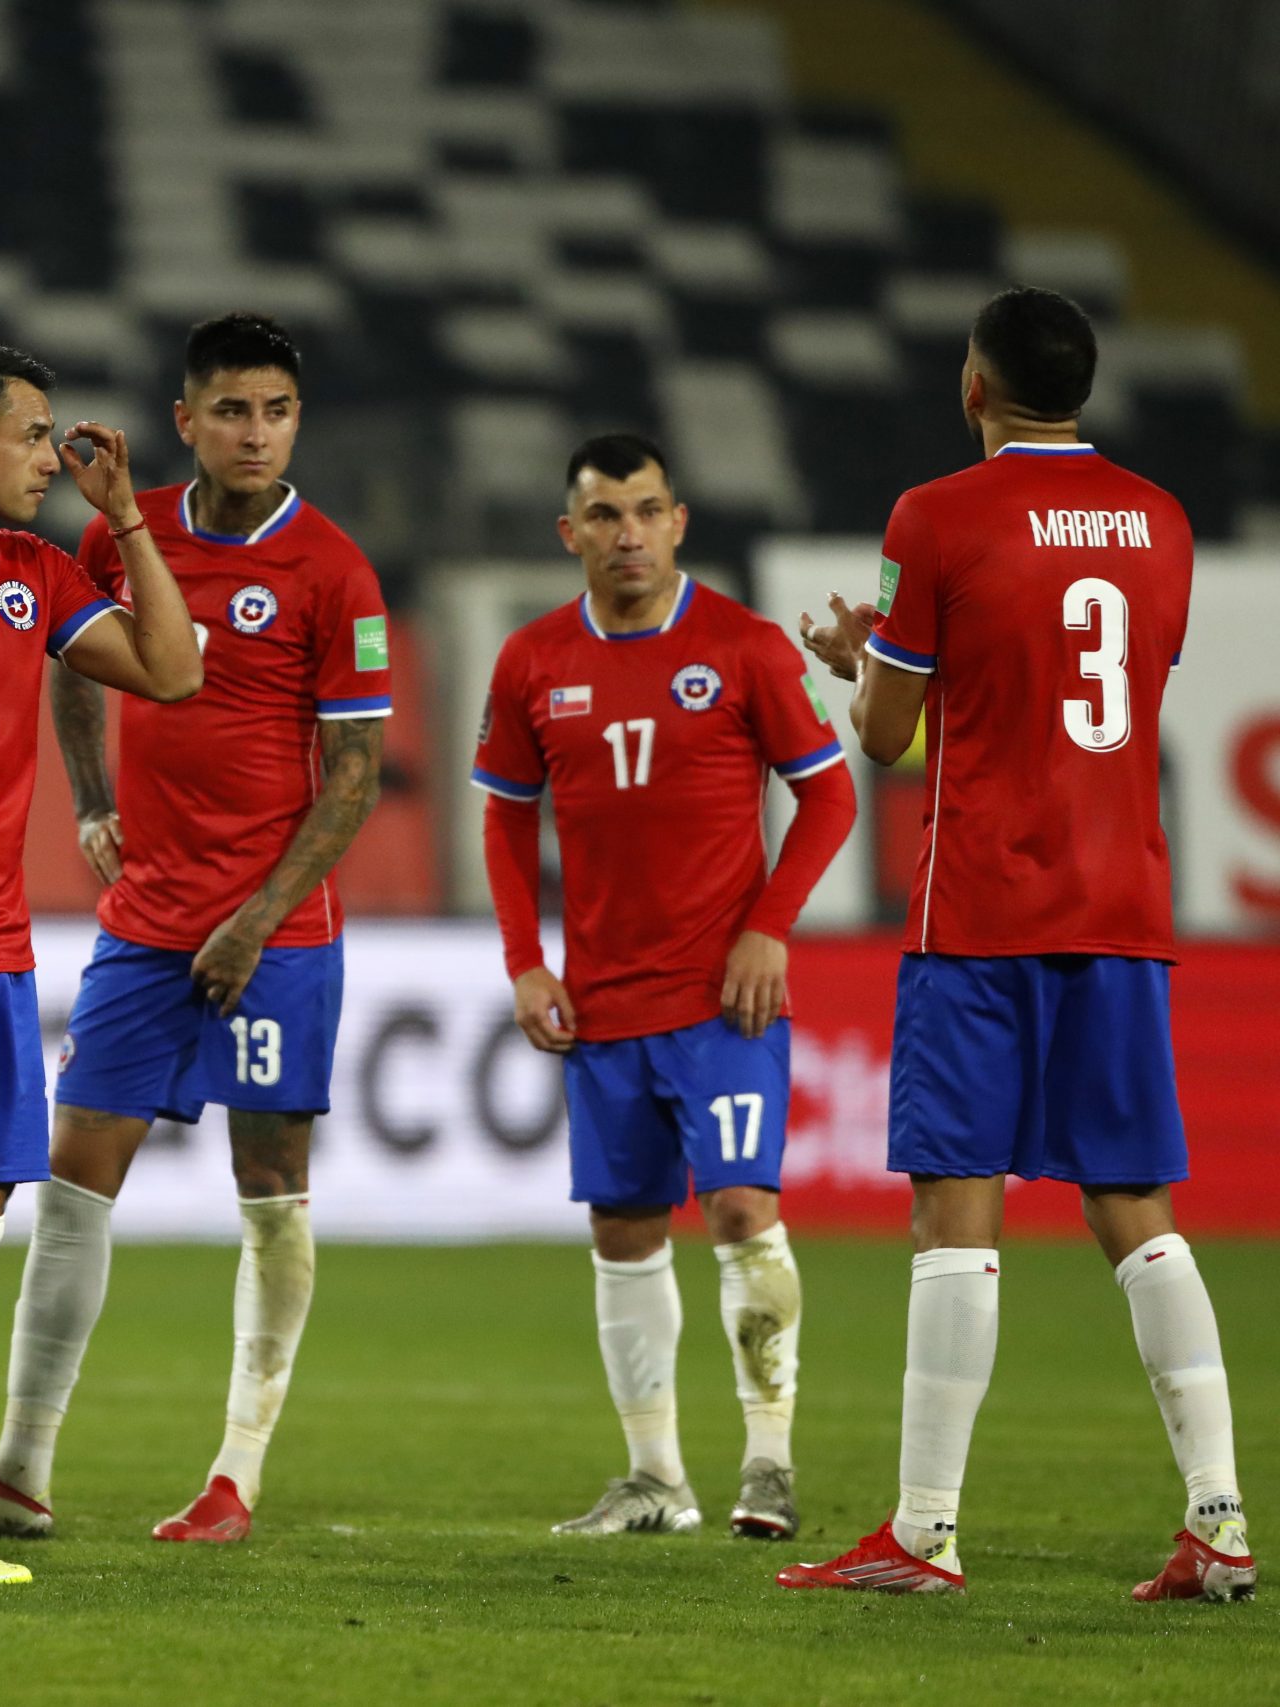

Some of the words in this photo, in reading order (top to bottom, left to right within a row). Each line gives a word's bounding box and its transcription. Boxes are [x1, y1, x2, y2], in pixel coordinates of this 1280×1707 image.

[1027, 509, 1152, 548] MARIPAN
[1062, 577, 1131, 753] 3
[602, 718, 656, 789] 17
[229, 1016, 282, 1086] 13
[708, 1092, 764, 1162] 17
